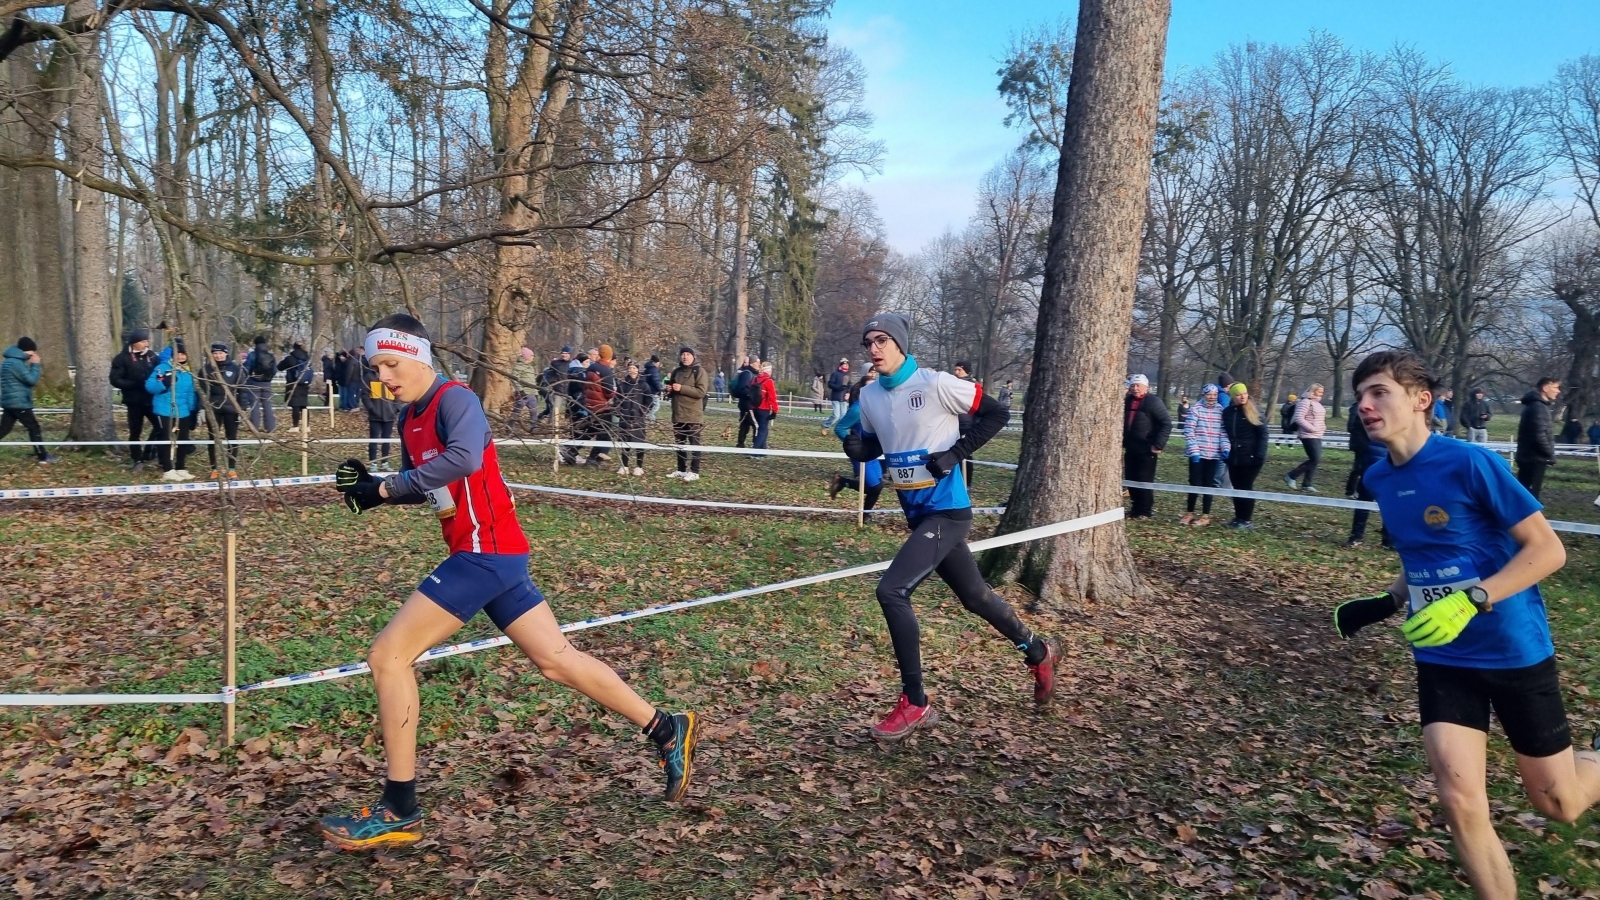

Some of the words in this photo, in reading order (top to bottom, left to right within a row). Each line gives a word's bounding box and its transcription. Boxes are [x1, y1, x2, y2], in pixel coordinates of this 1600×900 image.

[389, 332, 408, 341] LES
[376, 340, 419, 353] MARATON
[898, 467, 915, 479] 887
